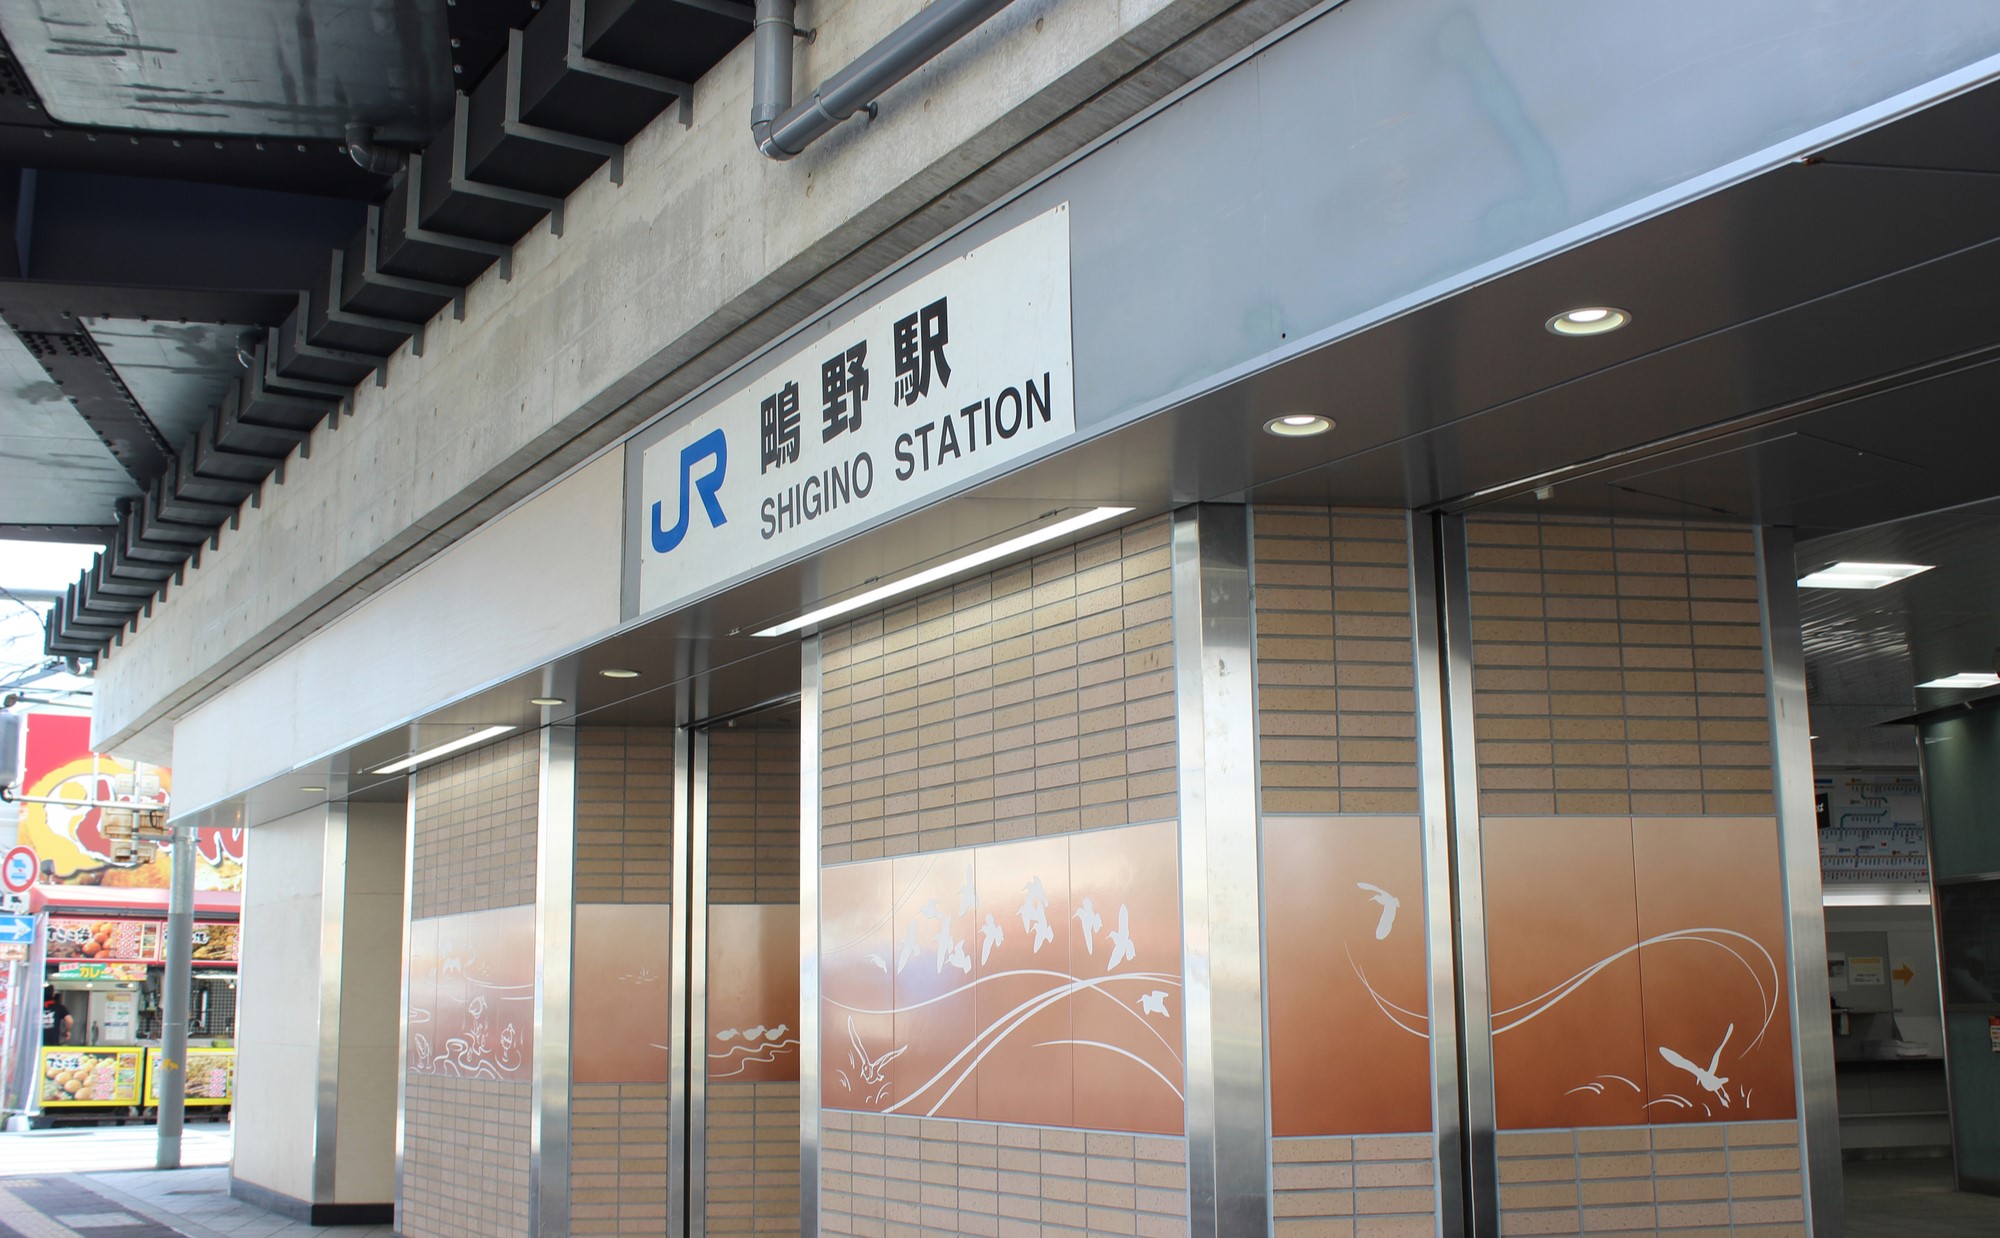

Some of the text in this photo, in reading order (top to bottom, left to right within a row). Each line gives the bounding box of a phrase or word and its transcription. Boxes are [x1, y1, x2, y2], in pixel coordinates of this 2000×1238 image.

[760, 296, 952, 476] 鴫野駅
[760, 372, 1052, 540] SHIGINO STATION
[651, 428, 728, 554] JR
